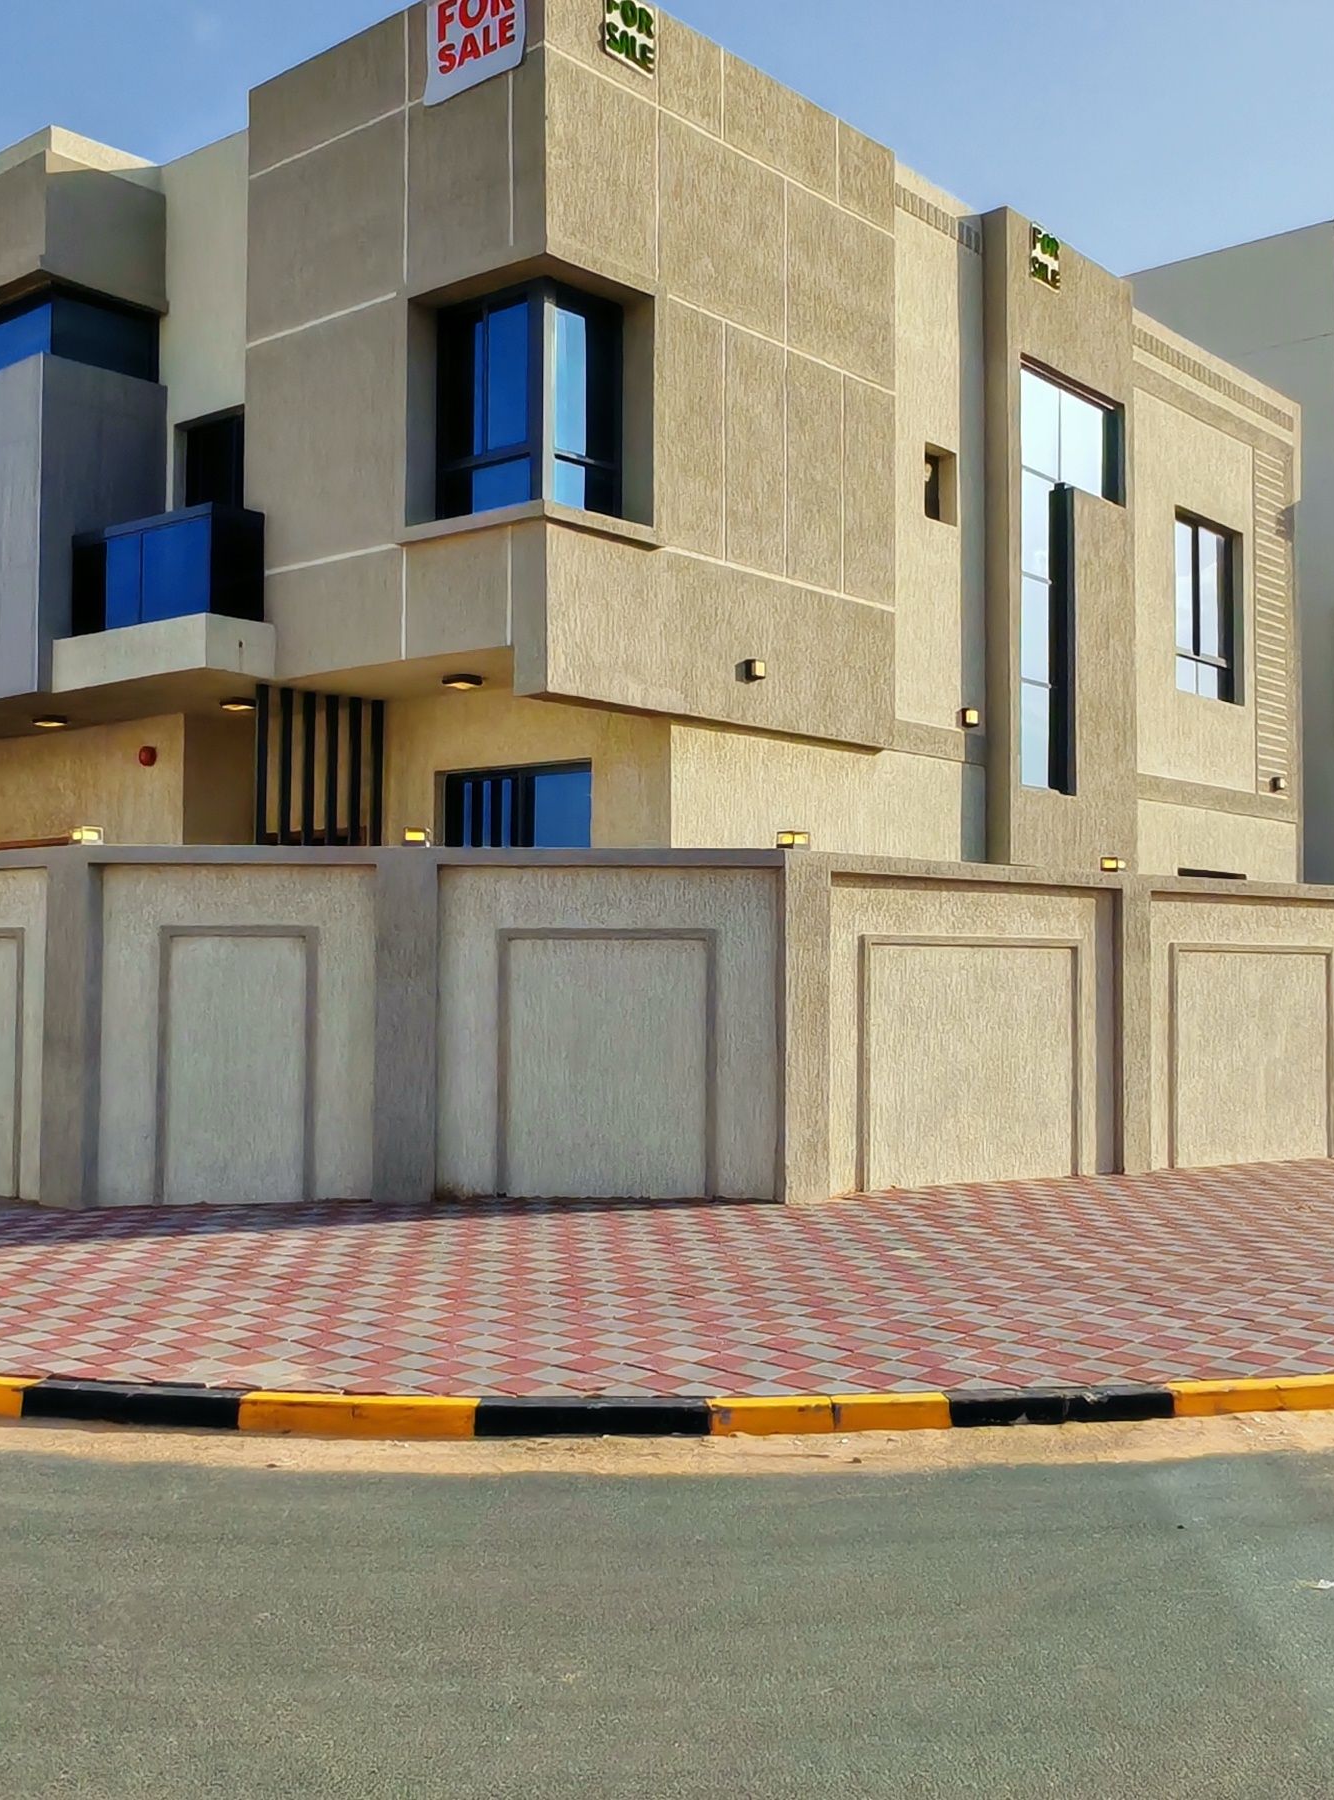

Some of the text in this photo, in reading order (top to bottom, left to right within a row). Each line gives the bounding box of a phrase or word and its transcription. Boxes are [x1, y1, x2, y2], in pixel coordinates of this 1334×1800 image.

[438, 12, 516, 74] SALE
[606, 21, 655, 74] SALE
[1031, 226, 1060, 261] FOR
[1030, 255, 1061, 290] SALE
